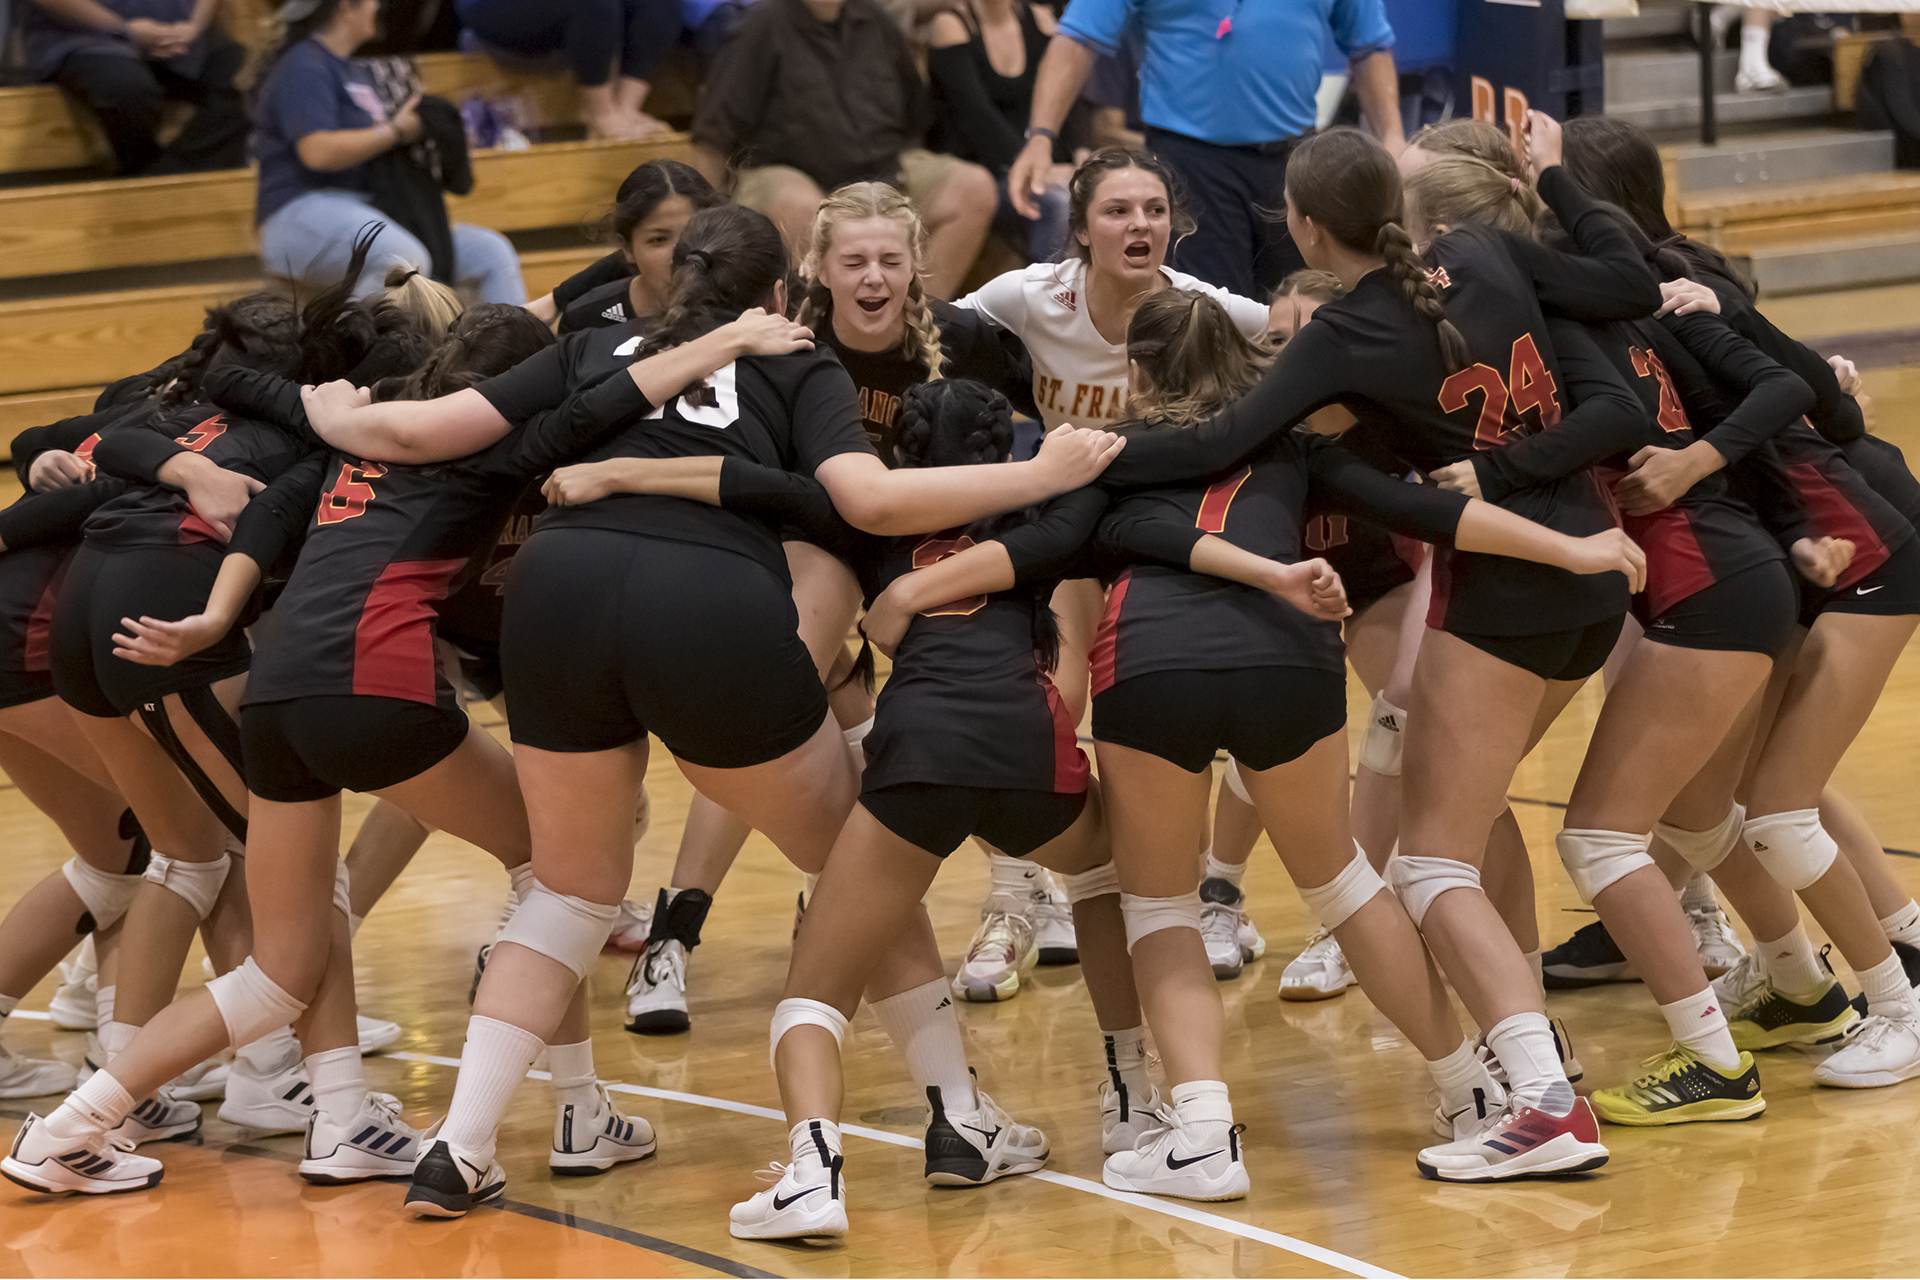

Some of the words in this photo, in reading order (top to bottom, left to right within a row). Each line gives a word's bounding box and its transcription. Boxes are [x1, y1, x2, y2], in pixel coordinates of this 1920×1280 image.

[1038, 375, 1065, 413] ST.
[1437, 332, 1562, 451] 24
[317, 460, 389, 526] 6
